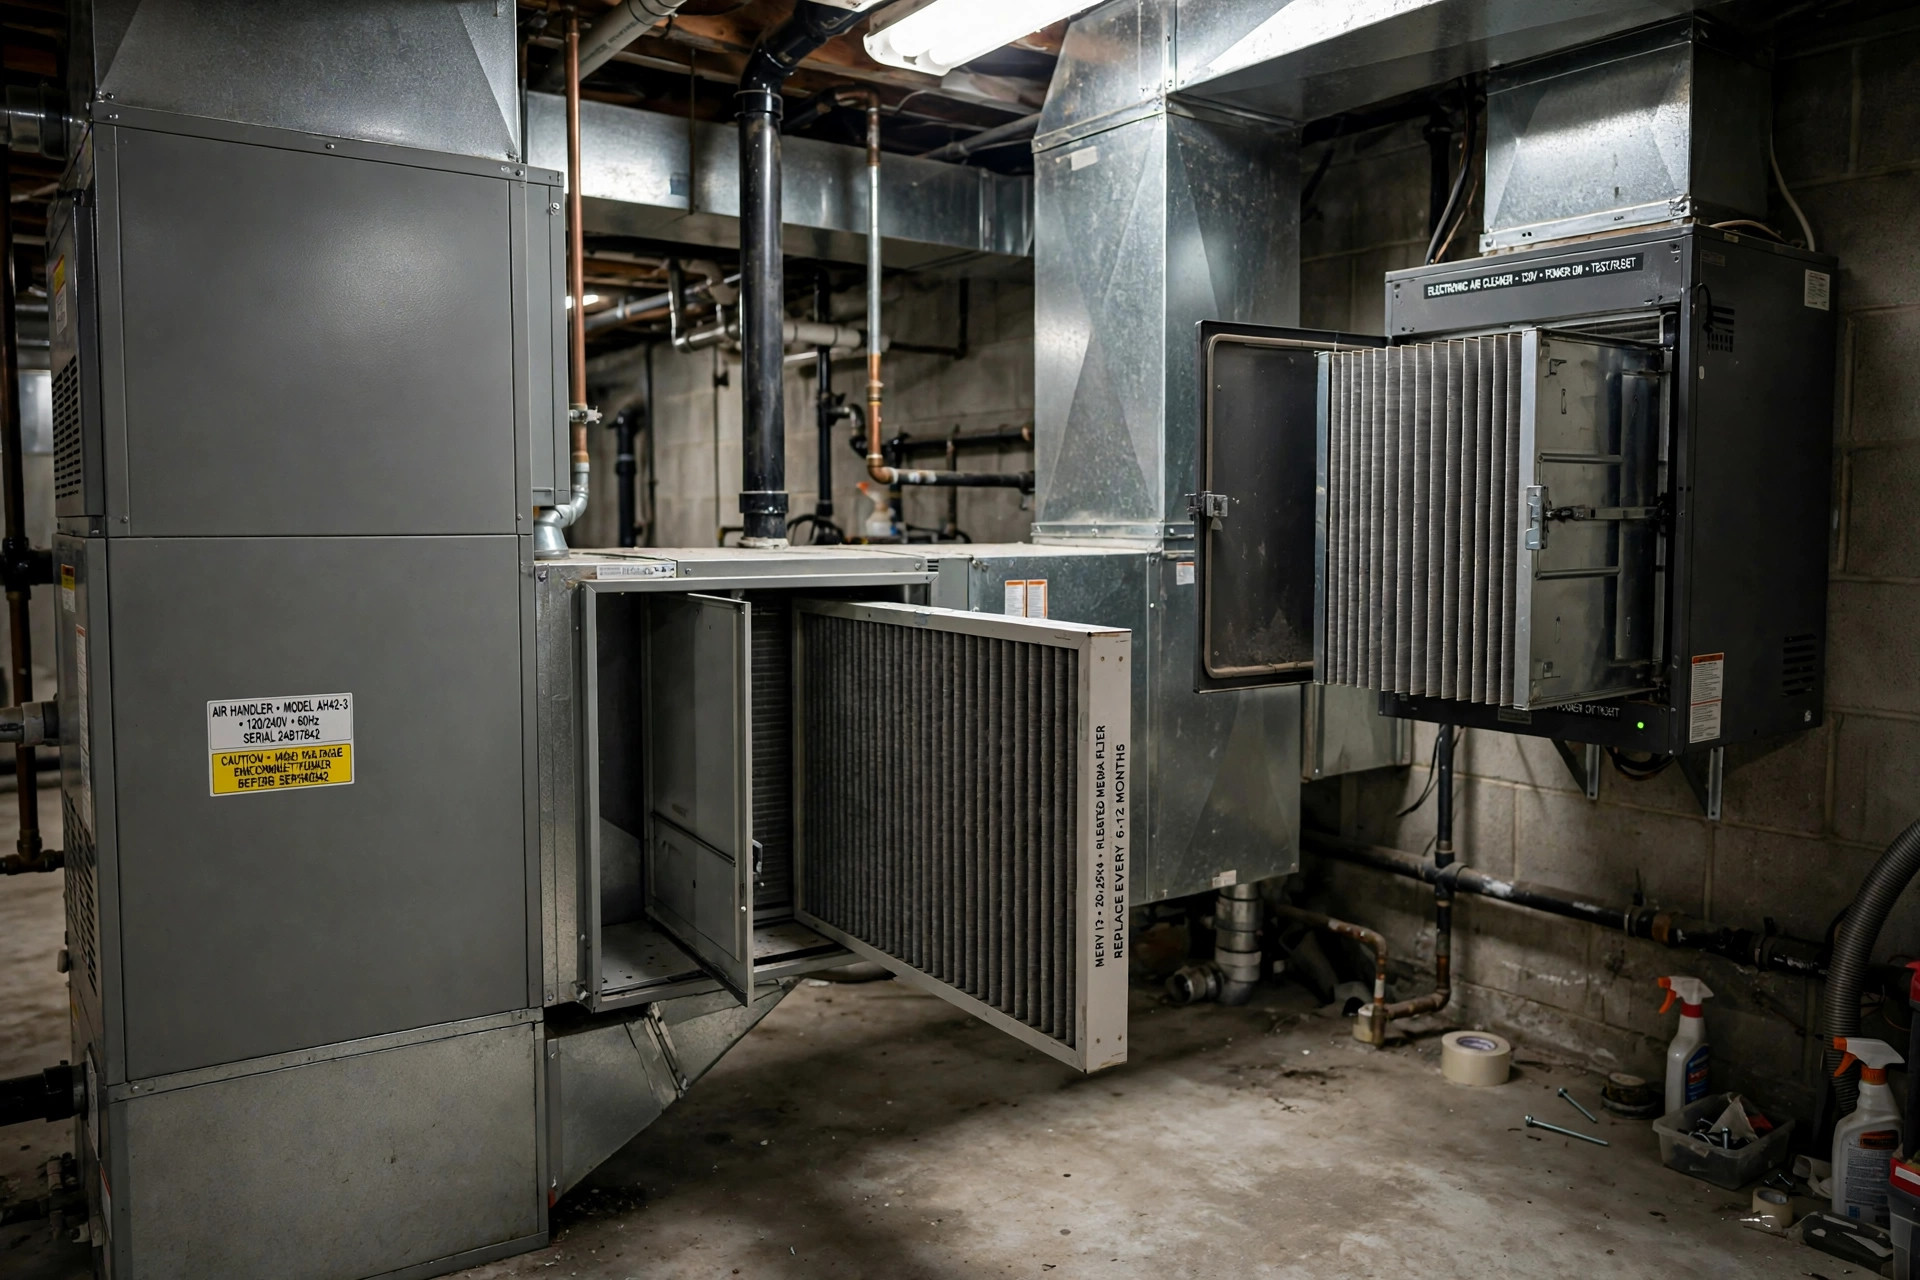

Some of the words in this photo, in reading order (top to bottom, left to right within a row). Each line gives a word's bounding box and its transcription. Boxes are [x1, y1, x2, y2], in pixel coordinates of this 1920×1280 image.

[212, 706, 227, 718] AIR
[230, 703, 274, 717] HANDLER
[283, 700, 314, 713] MODEL
[317, 699, 349, 711] AH42-3
[243, 732, 276, 744] SERIAL
[1115, 744, 1125, 803] MONTHS
[1114, 845, 1125, 892] EVERY
[1114, 894, 1124, 959] REPLACE
